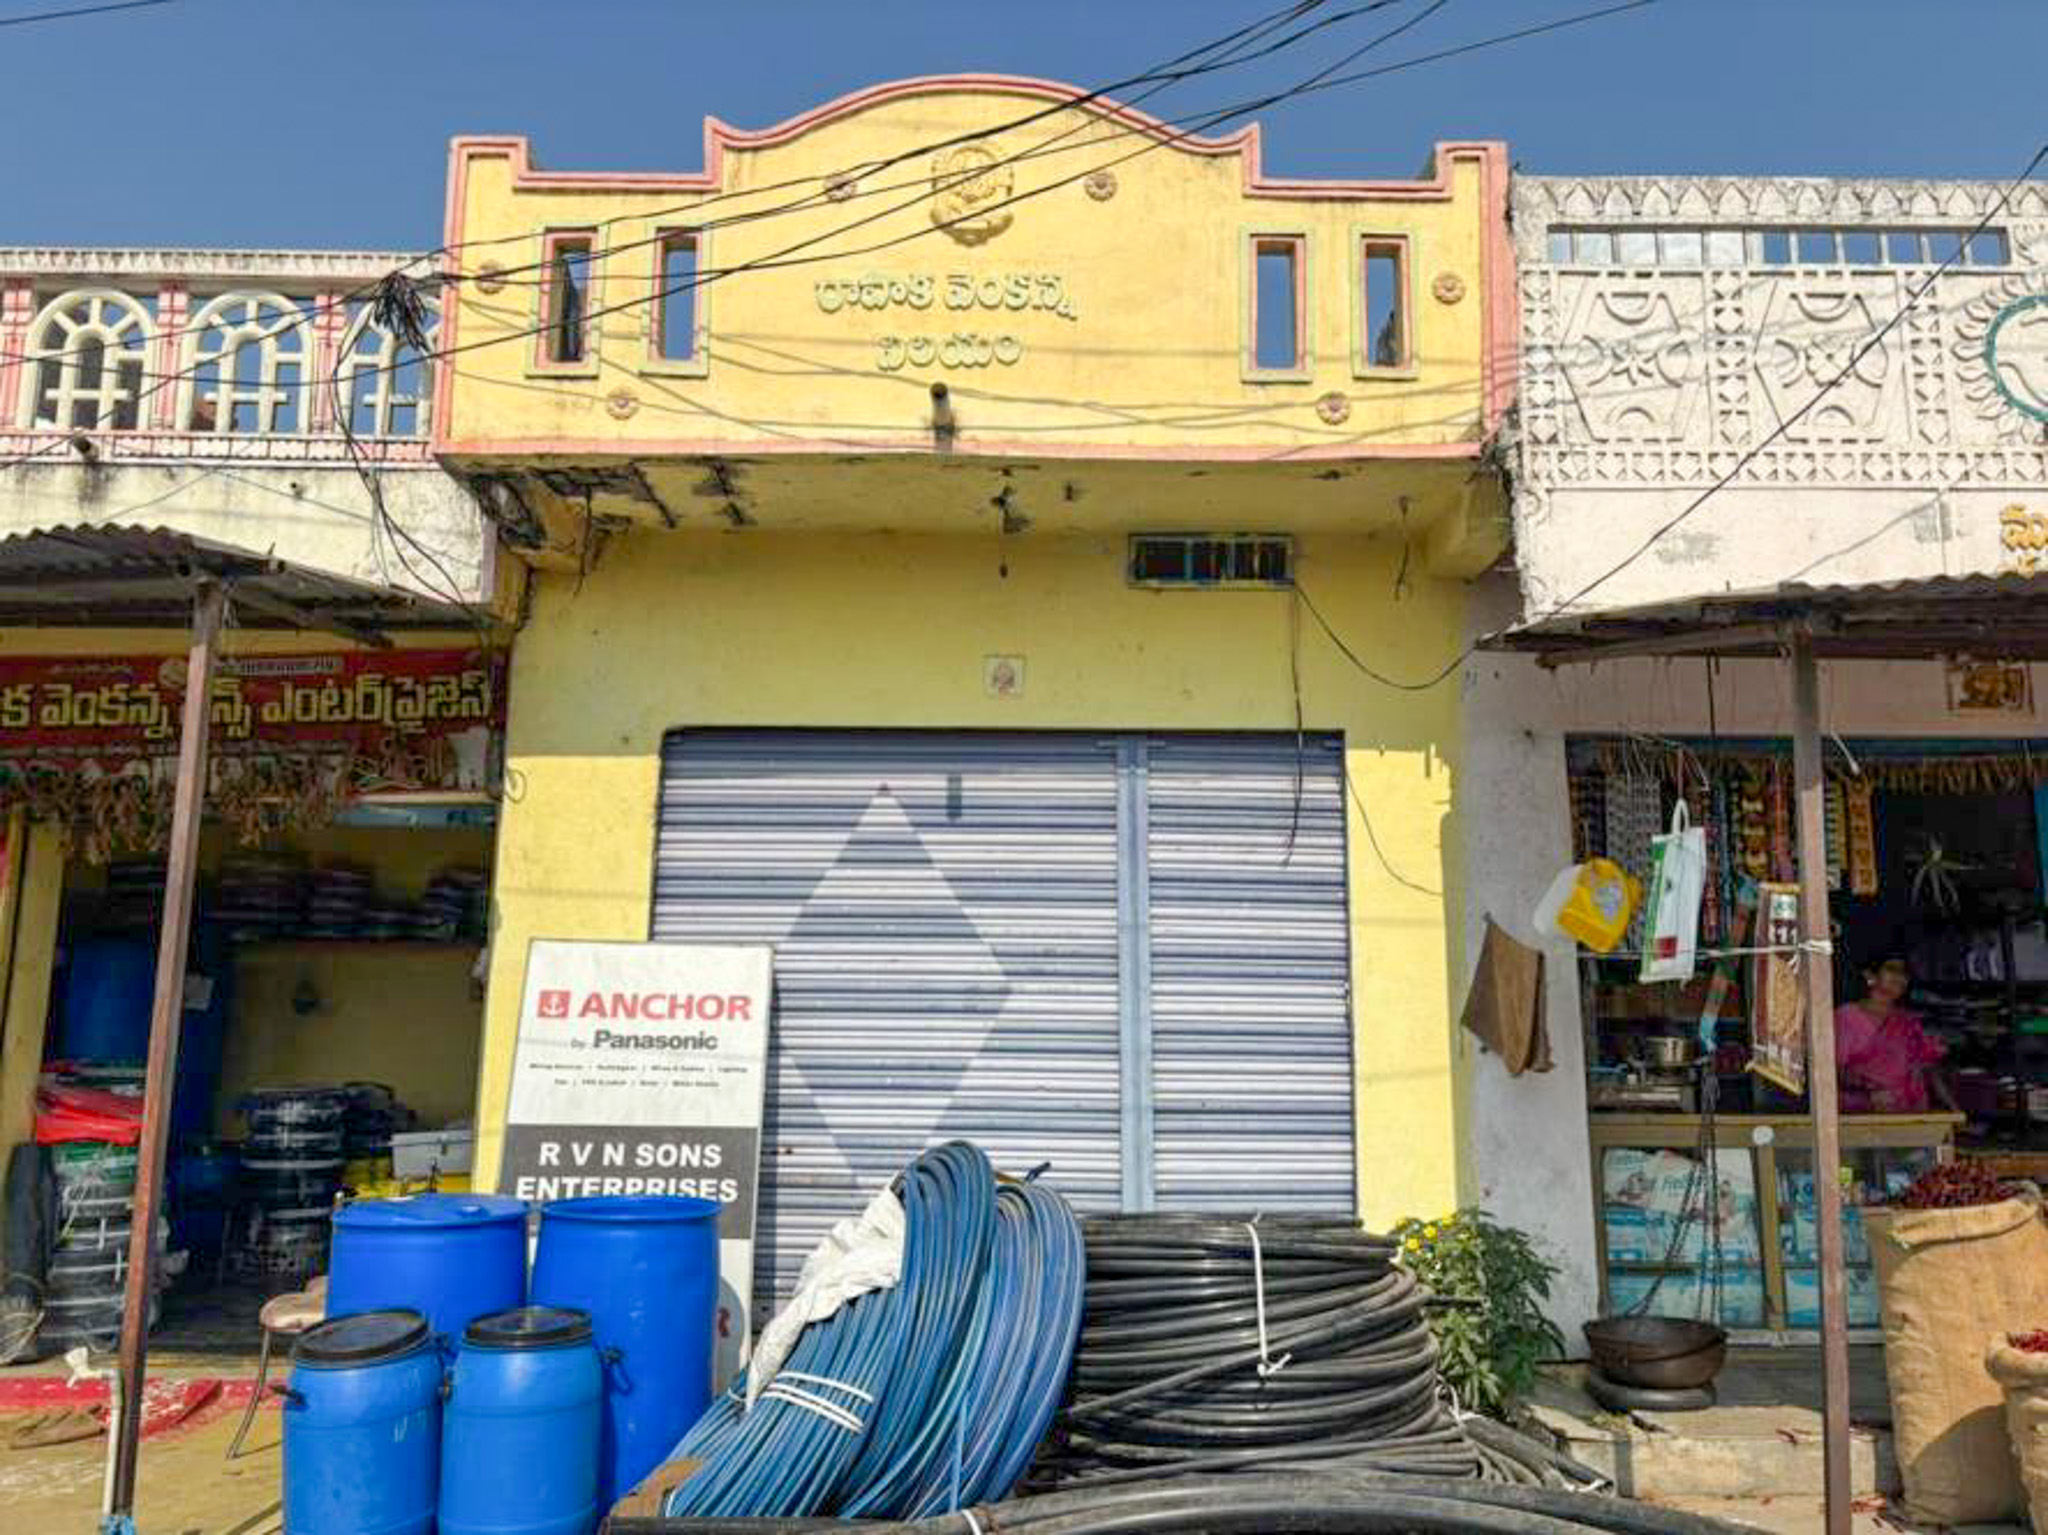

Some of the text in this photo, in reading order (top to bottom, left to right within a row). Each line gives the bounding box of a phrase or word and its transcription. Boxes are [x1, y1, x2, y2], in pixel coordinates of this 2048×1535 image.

[943, 273, 1077, 321] వెంకన్న
[877, 333, 1020, 370] నిలయం
[40, 683, 168, 739] వెంకన్న
[578, 991, 752, 1021] ANCHOR
[593, 1029, 718, 1050] Panasonic
[539, 1143, 723, 1168] R V N SONS
[515, 1177, 739, 1203] ENTERPRISES
